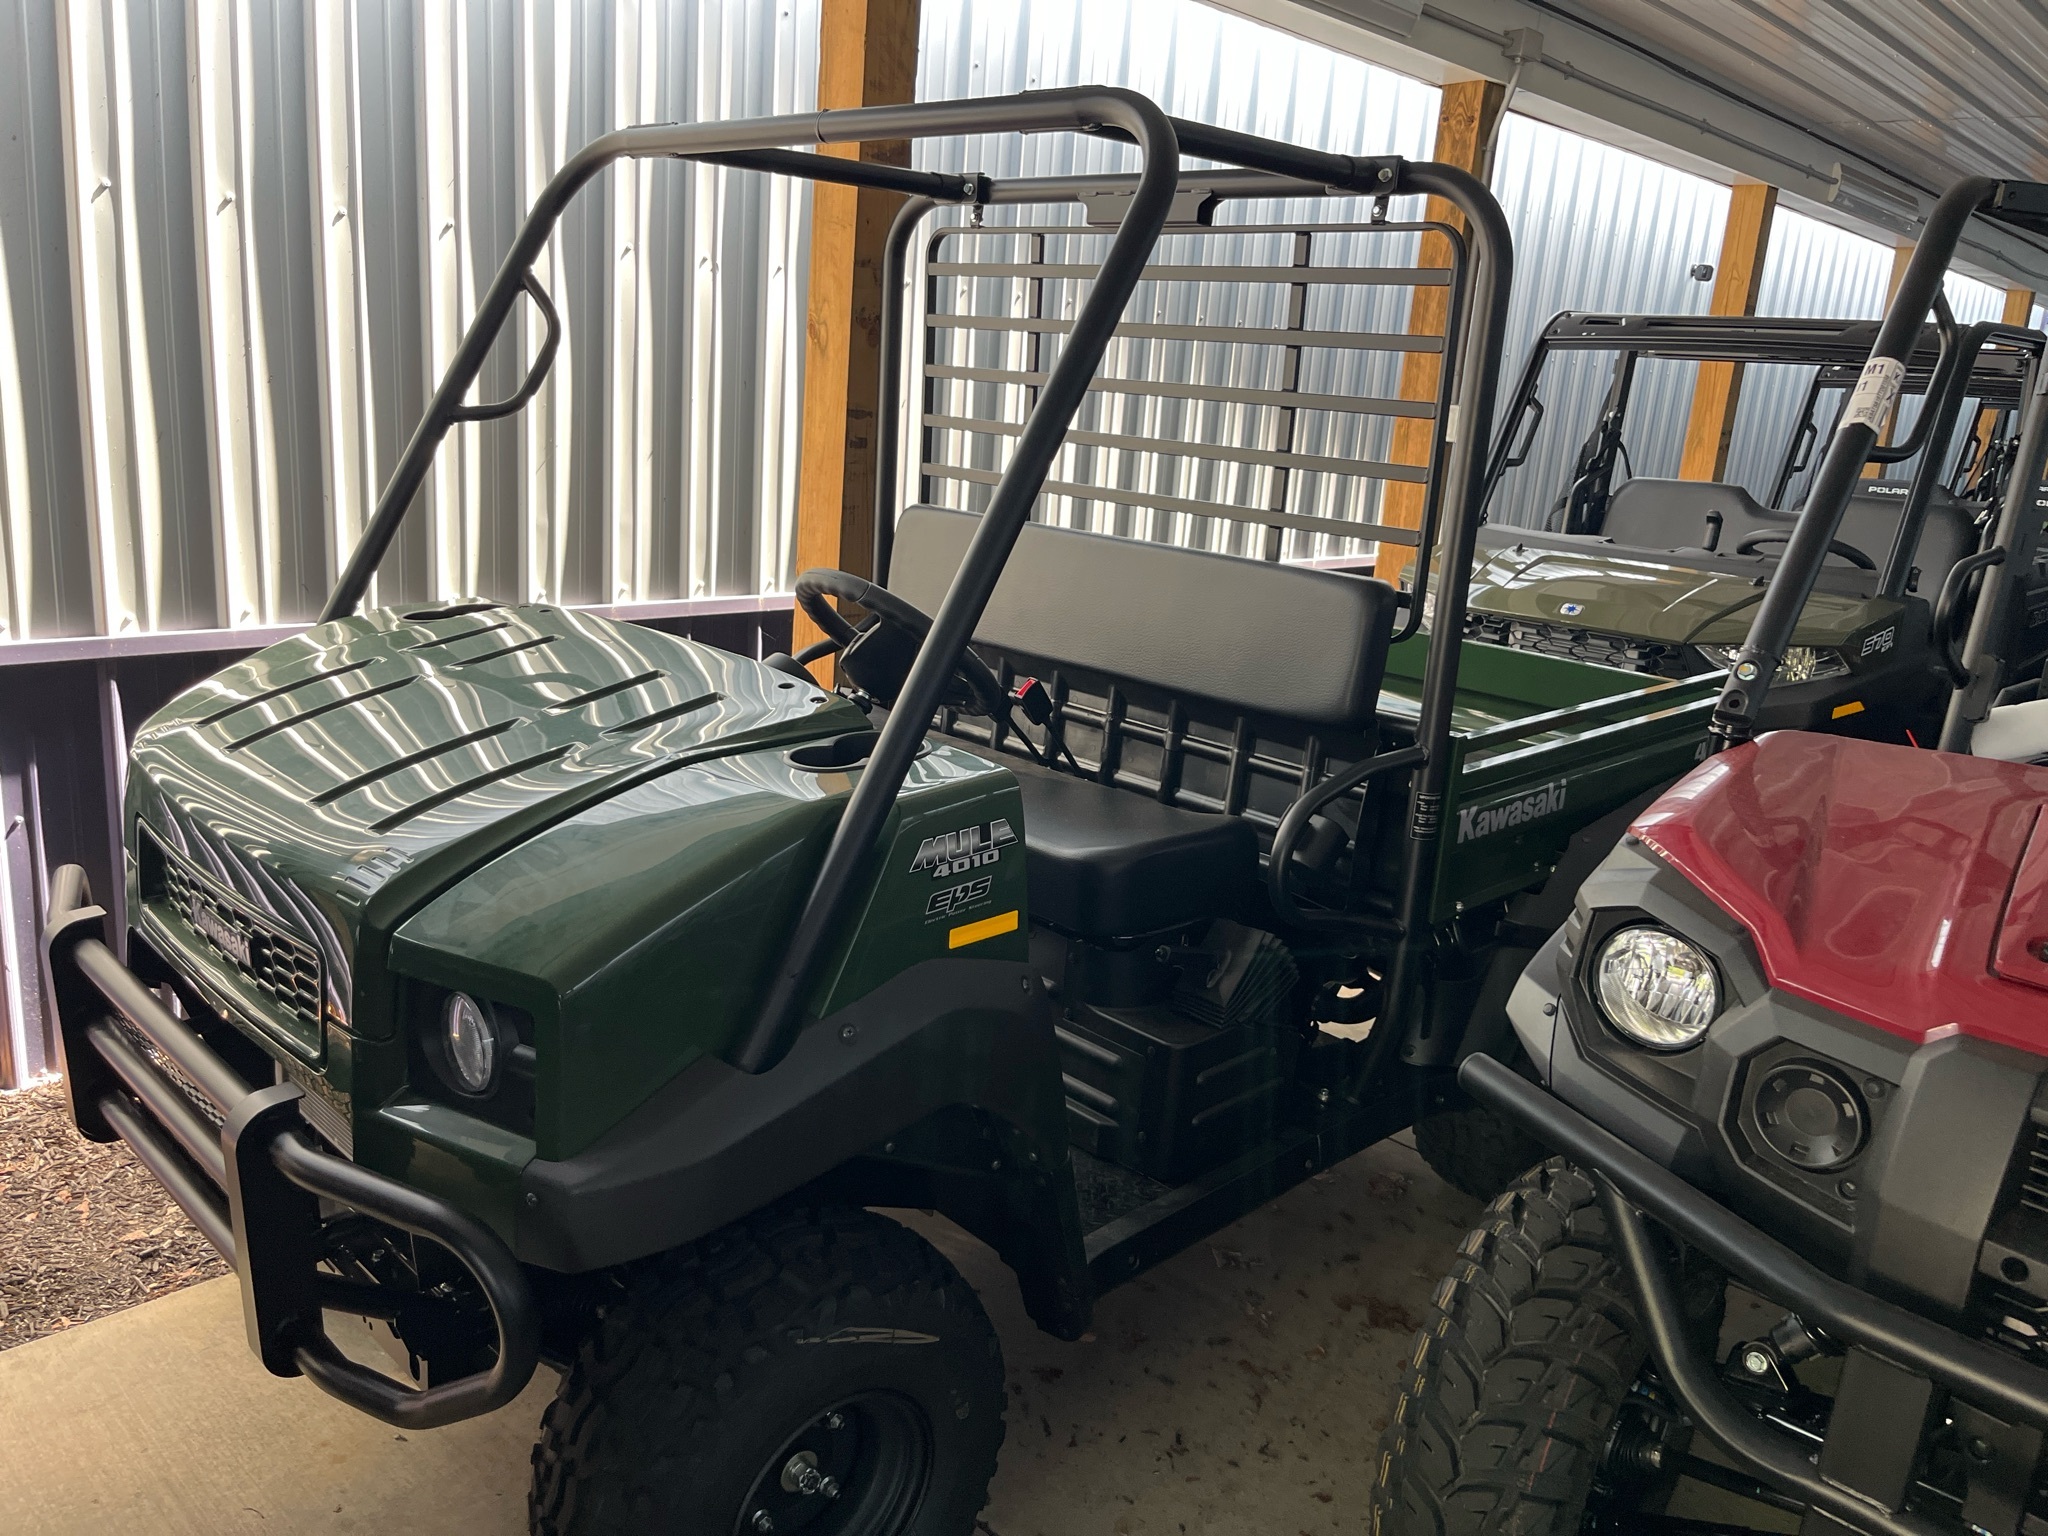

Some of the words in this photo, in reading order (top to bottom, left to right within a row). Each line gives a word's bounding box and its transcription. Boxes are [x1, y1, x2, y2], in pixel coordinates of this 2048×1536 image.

[1861, 626, 1895, 657] 570
[1457, 779, 1567, 844] Kawasaki
[909, 818, 1018, 873] MULE
[932, 849, 1000, 878] 4010
[925, 875, 993, 915] EPS
[191, 897, 252, 967] Kawasaki
